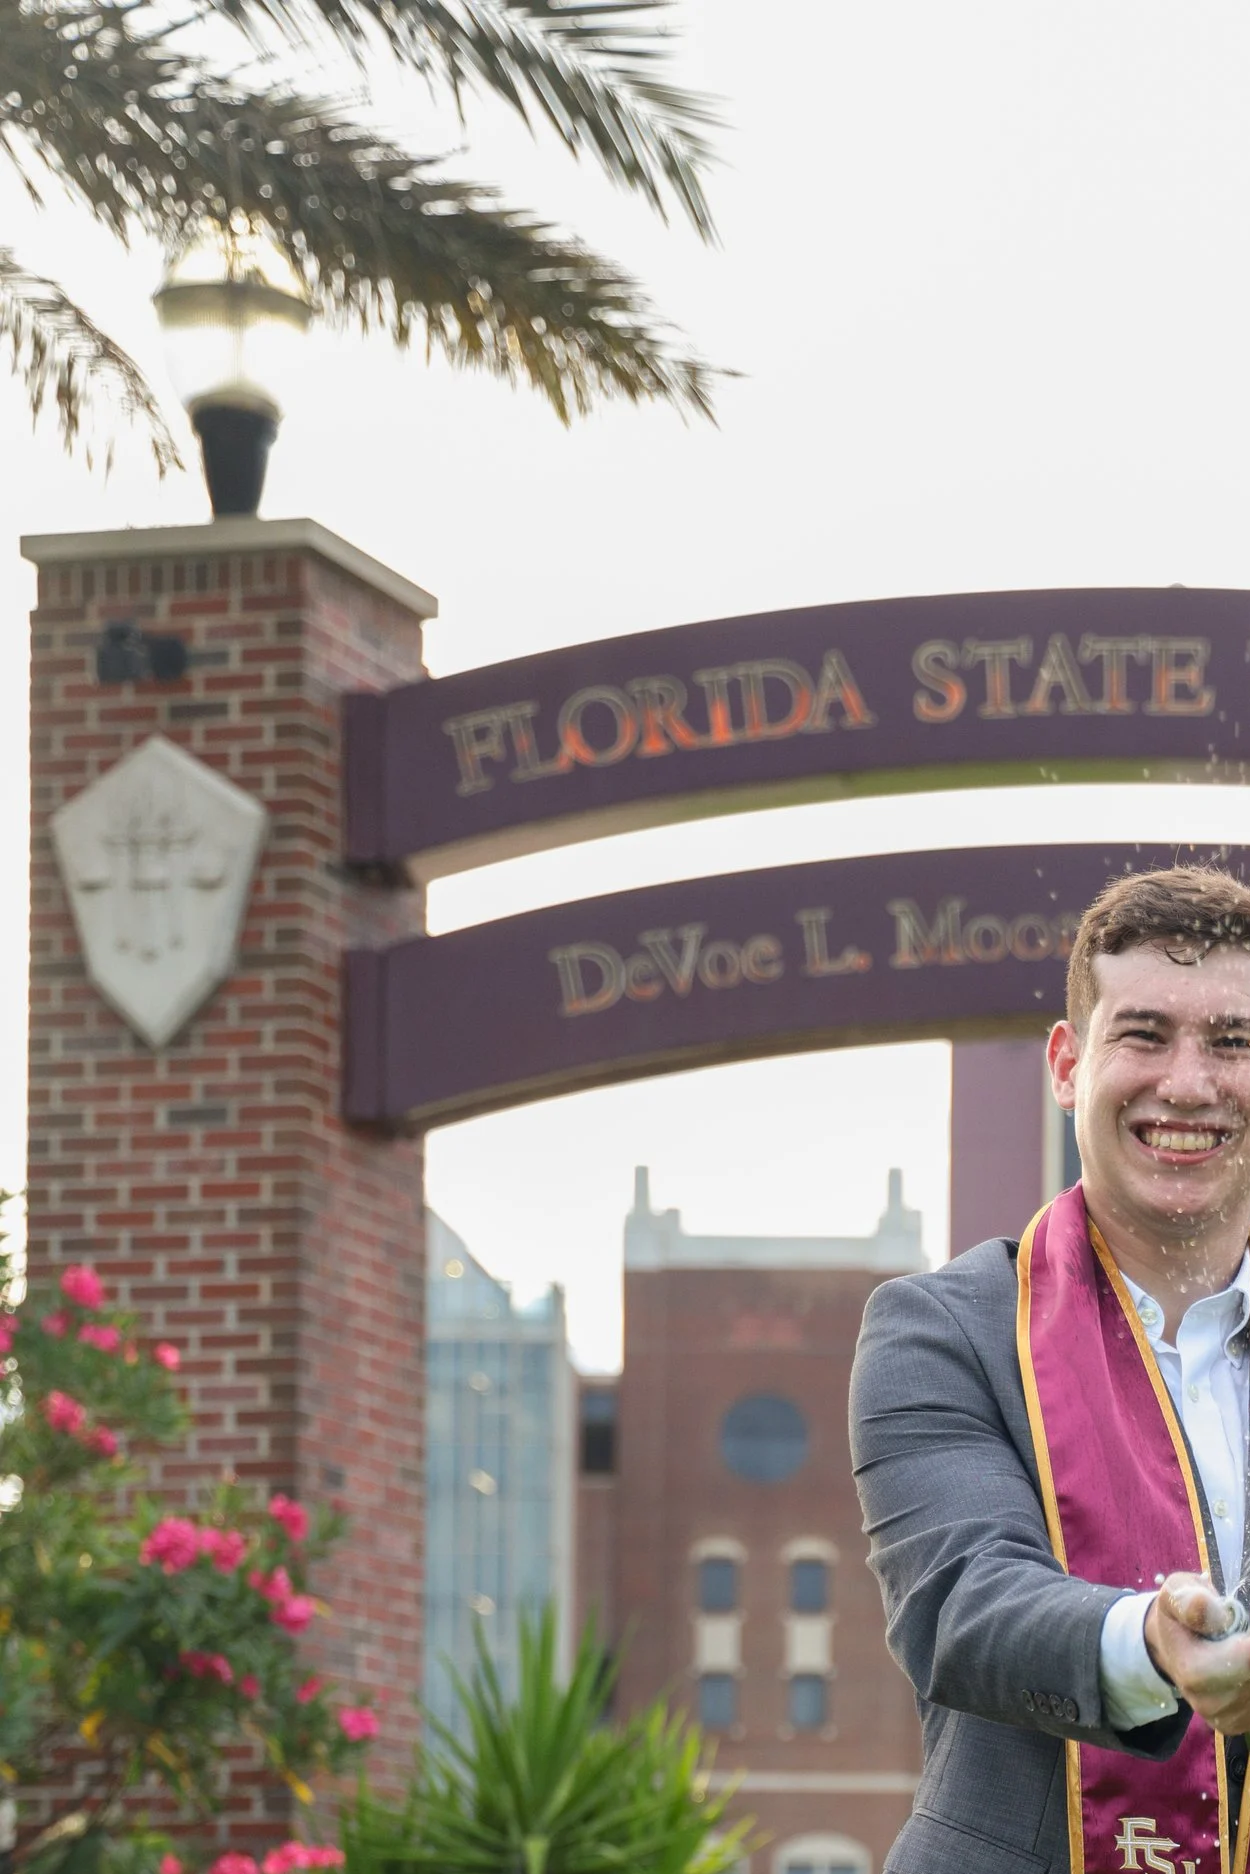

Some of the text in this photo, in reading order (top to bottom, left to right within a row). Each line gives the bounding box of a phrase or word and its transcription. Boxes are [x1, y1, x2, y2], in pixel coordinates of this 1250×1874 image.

[444, 651, 873, 794] FLORIDA
[912, 634, 1213, 721] STATE
[551, 924, 783, 1016] DeVoe
[798, 906, 872, 976] L.
[886, 897, 1080, 969] Moor
